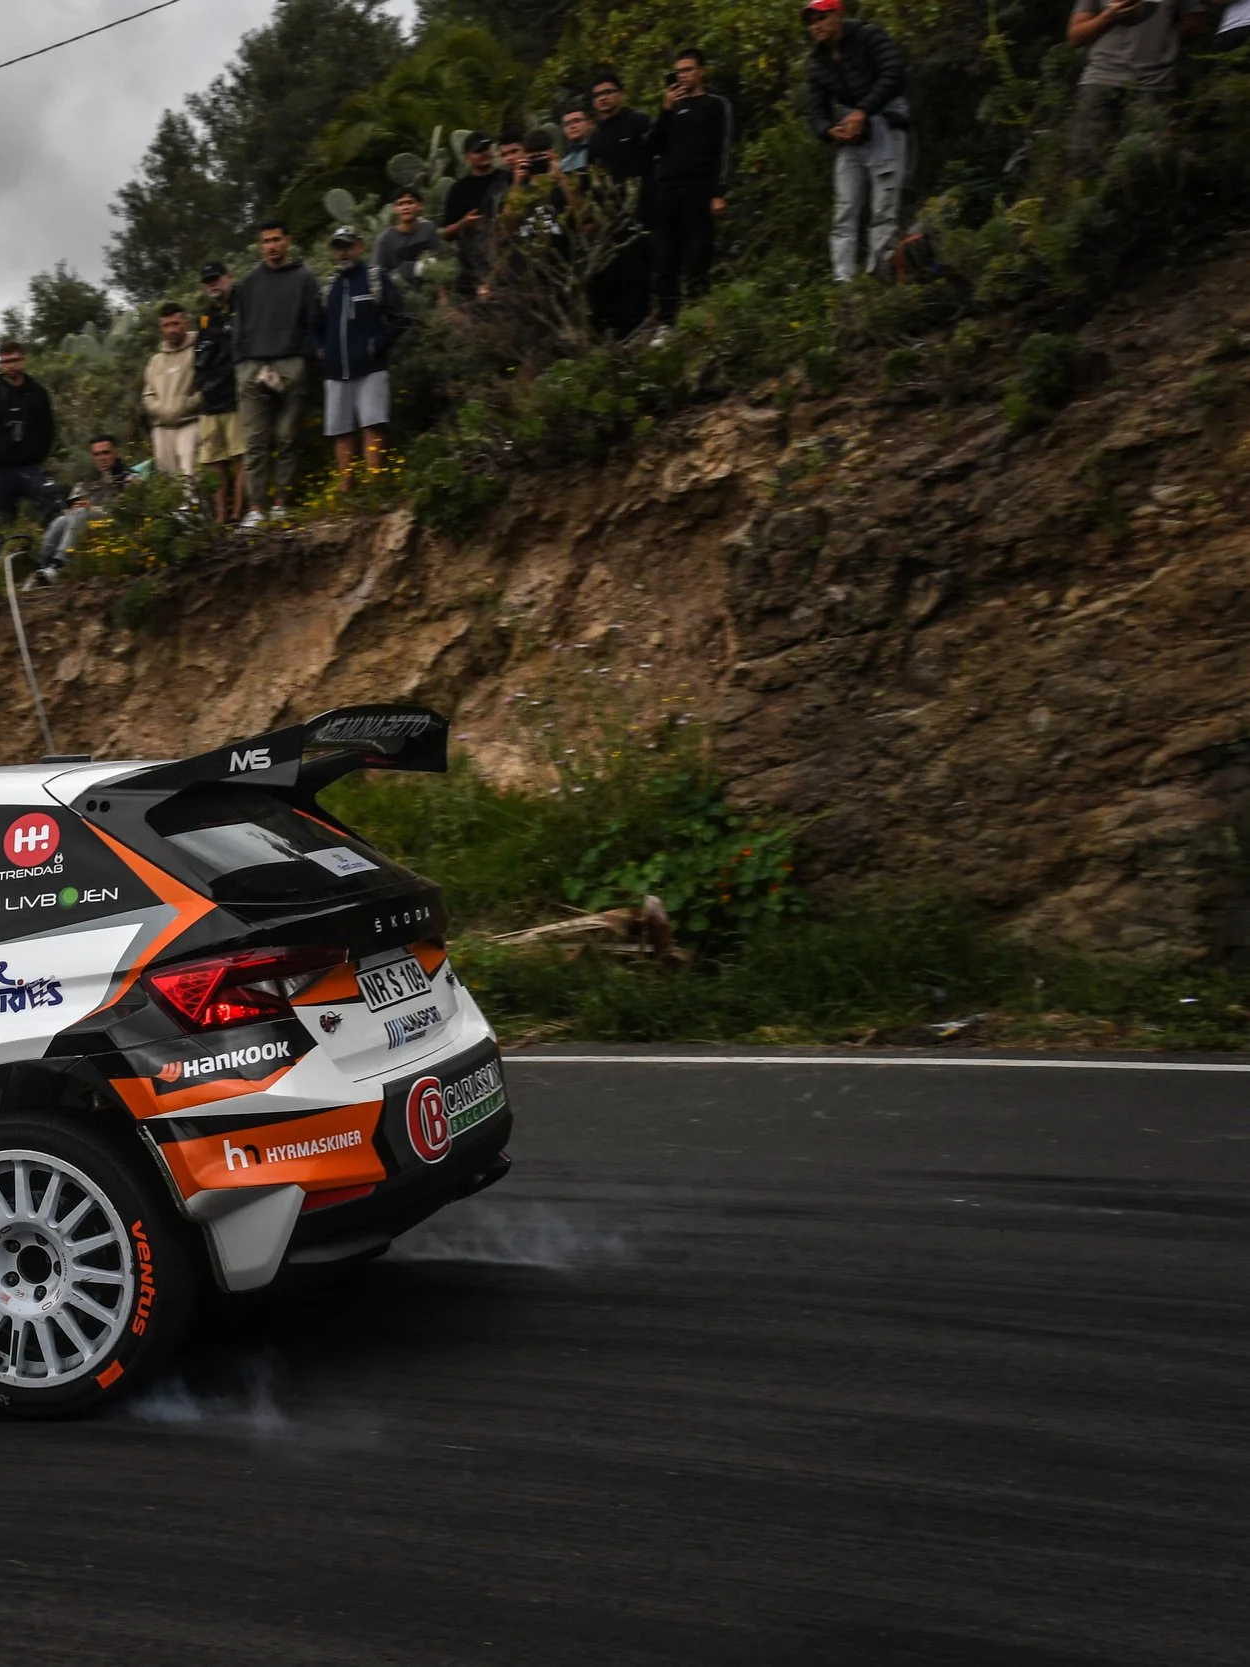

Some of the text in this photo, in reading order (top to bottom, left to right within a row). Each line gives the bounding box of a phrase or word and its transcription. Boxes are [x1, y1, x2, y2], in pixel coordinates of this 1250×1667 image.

[229, 748, 272, 772] MS
[374, 906, 431, 933] ŠKODA
[360, 961, 427, 1007] NR S 109
[266, 1129, 363, 1164] HYRMASKINER
